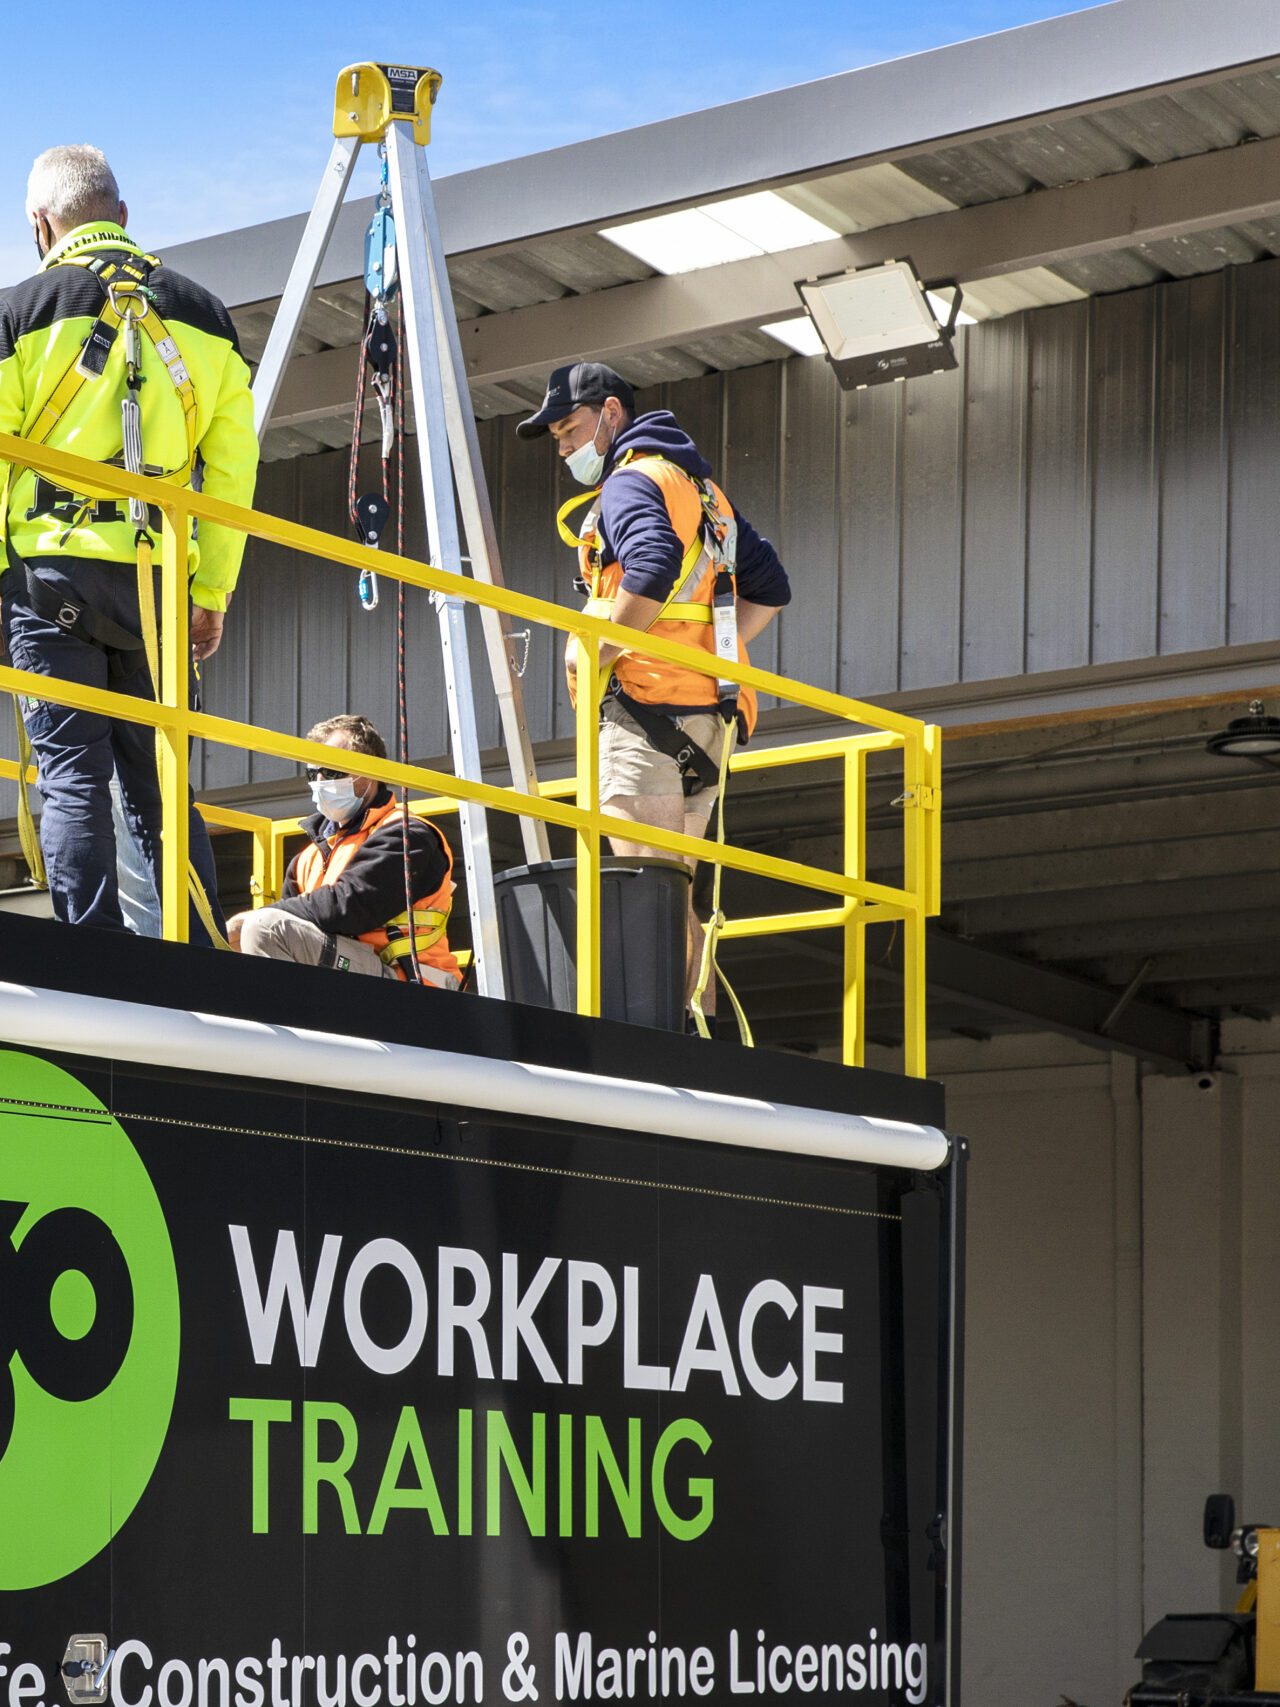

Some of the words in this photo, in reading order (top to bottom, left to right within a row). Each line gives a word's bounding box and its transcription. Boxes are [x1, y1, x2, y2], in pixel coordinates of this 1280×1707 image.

[389, 69, 416, 79] MSA
[229, 1224, 844, 1404] WORKPLACE
[229, 1397, 714, 1541] TRAINING
[111, 1634, 484, 1707] Construction
[502, 1631, 538, 1702] &
[555, 1630, 714, 1700] Marine
[730, 1628, 928, 1705] Licensing
